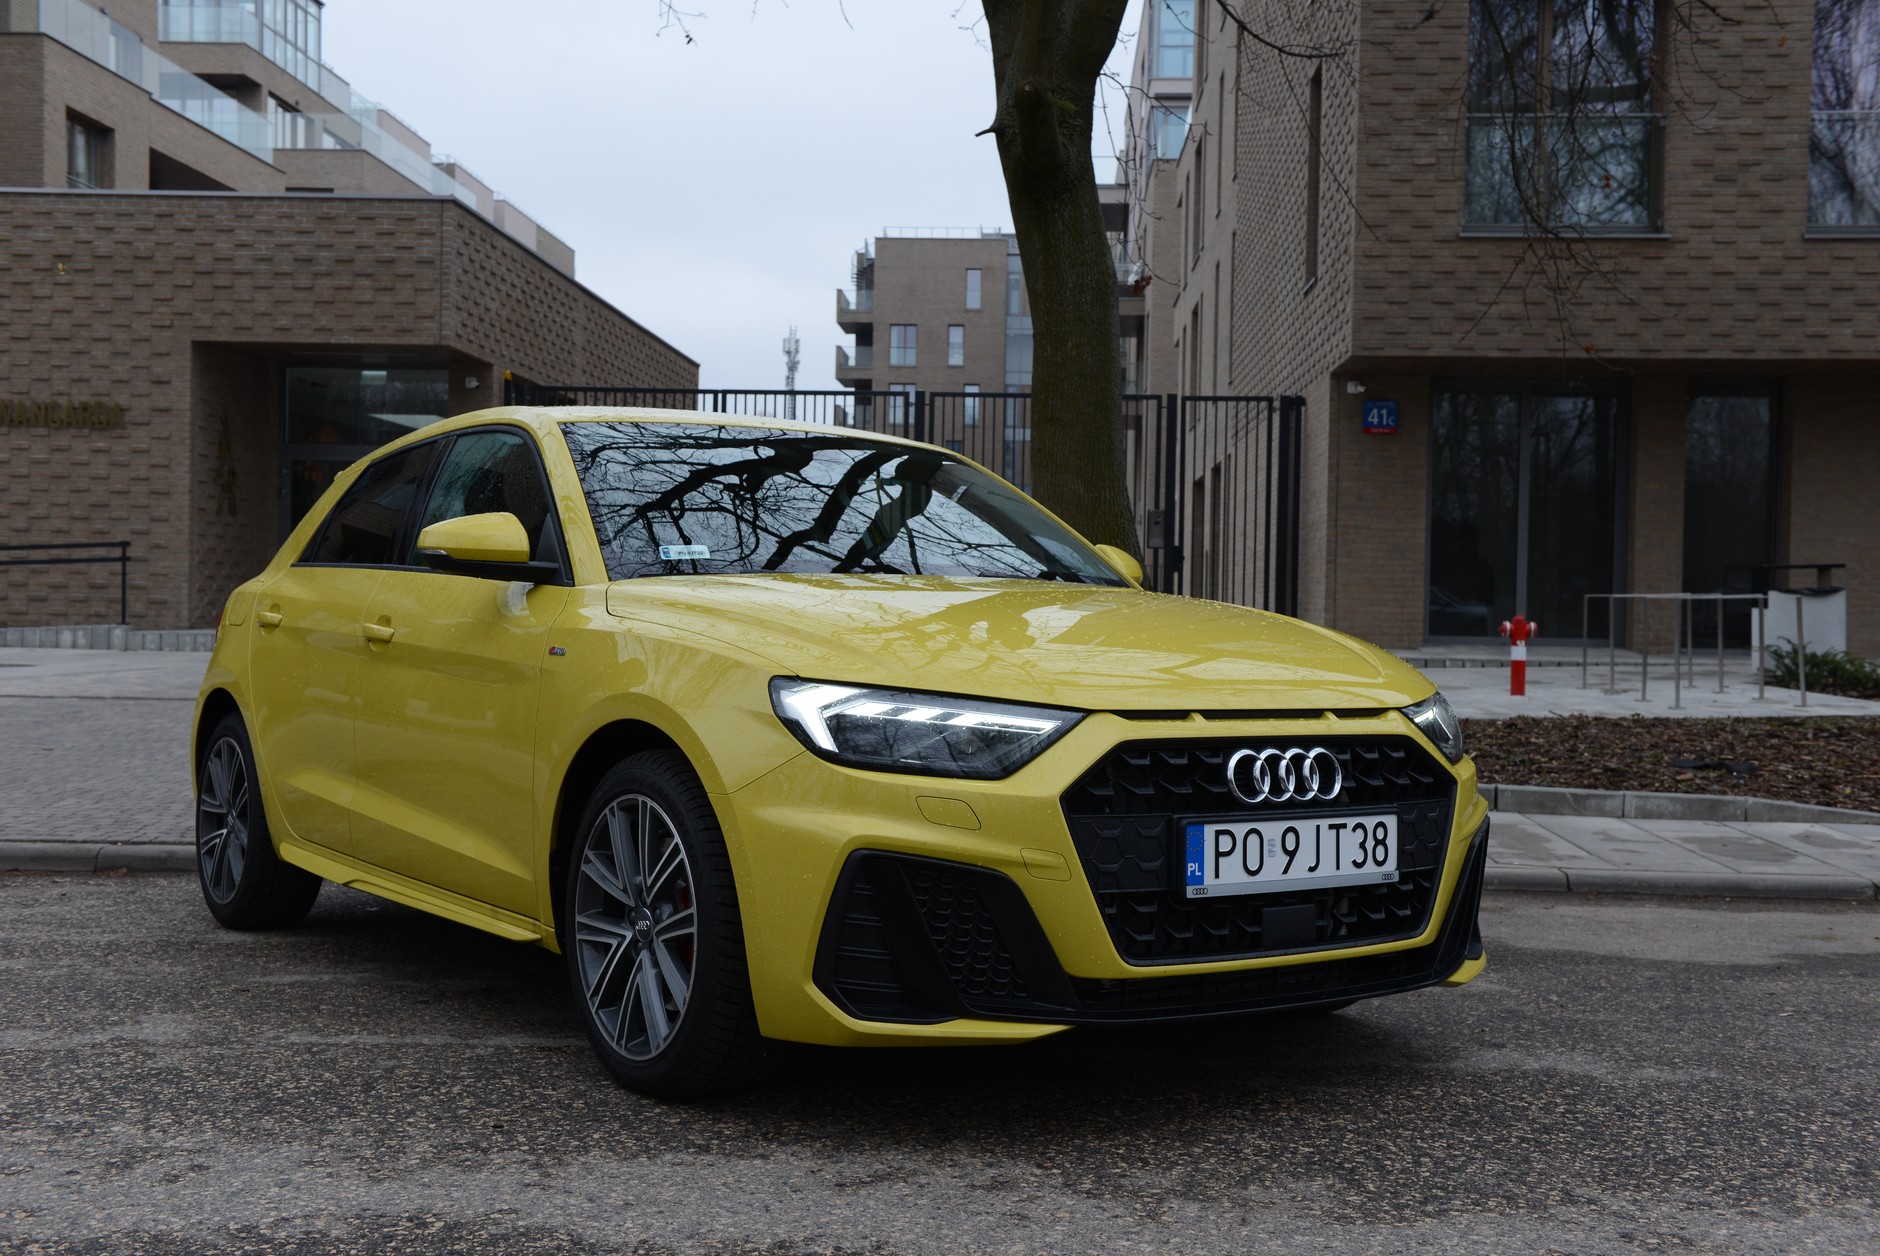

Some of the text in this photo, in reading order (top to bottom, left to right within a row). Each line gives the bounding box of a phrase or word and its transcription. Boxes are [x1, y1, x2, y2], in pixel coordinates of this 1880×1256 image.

[1214, 820, 1389, 879] PO 9JT38
[1187, 862, 1202, 876] PL
